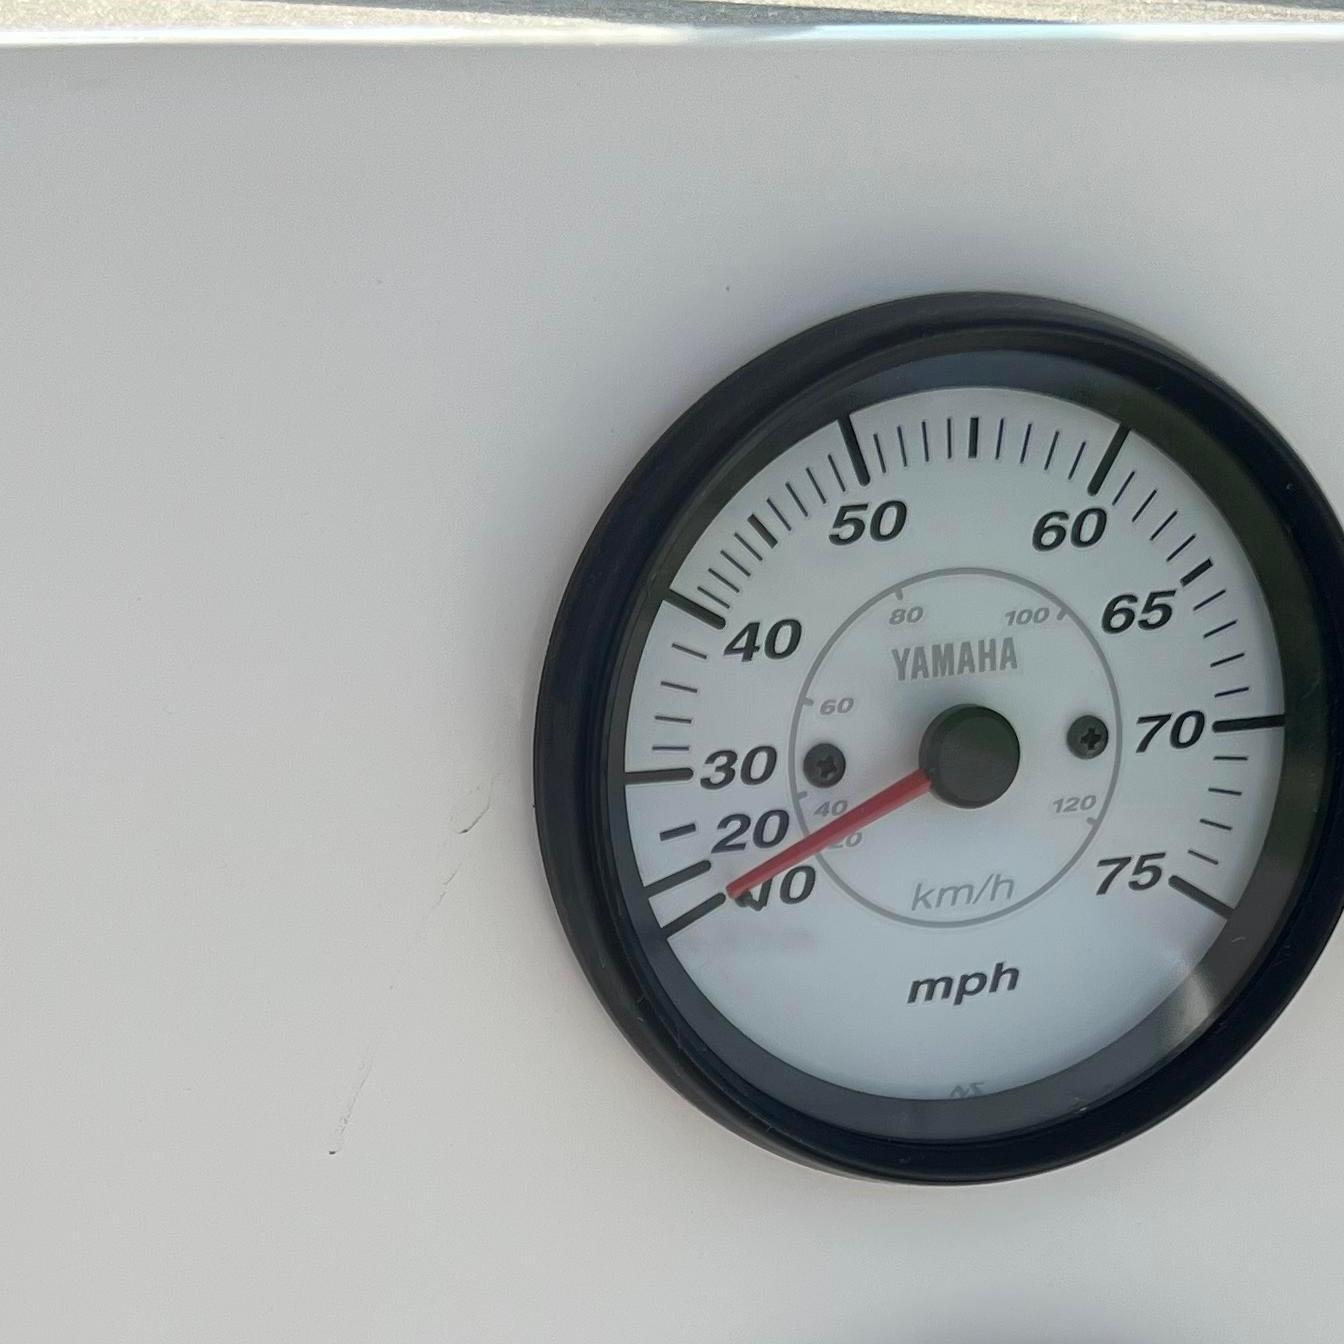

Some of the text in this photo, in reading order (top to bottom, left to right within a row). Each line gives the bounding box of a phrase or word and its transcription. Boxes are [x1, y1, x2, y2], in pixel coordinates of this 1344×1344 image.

[829, 500, 907, 546] 50
[1032, 507, 1108, 552] 60
[888, 606, 924, 625] 80
[1005, 607, 1050, 626] 100
[1101, 590, 1176, 634] 65
[723, 619, 802, 662] 40
[892, 637, 1018, 681] YAMAHA
[819, 697, 854, 715] 60
[1136, 710, 1206, 753] 70
[700, 745, 778, 790] 30
[814, 800, 848, 818] 40
[1053, 794, 1097, 813] 120
[711, 809, 790, 854] 20
[911, 873, 1015, 911] km/h
[1095, 852, 1167, 896] 75
[907, 961, 1020, 1005] mph
